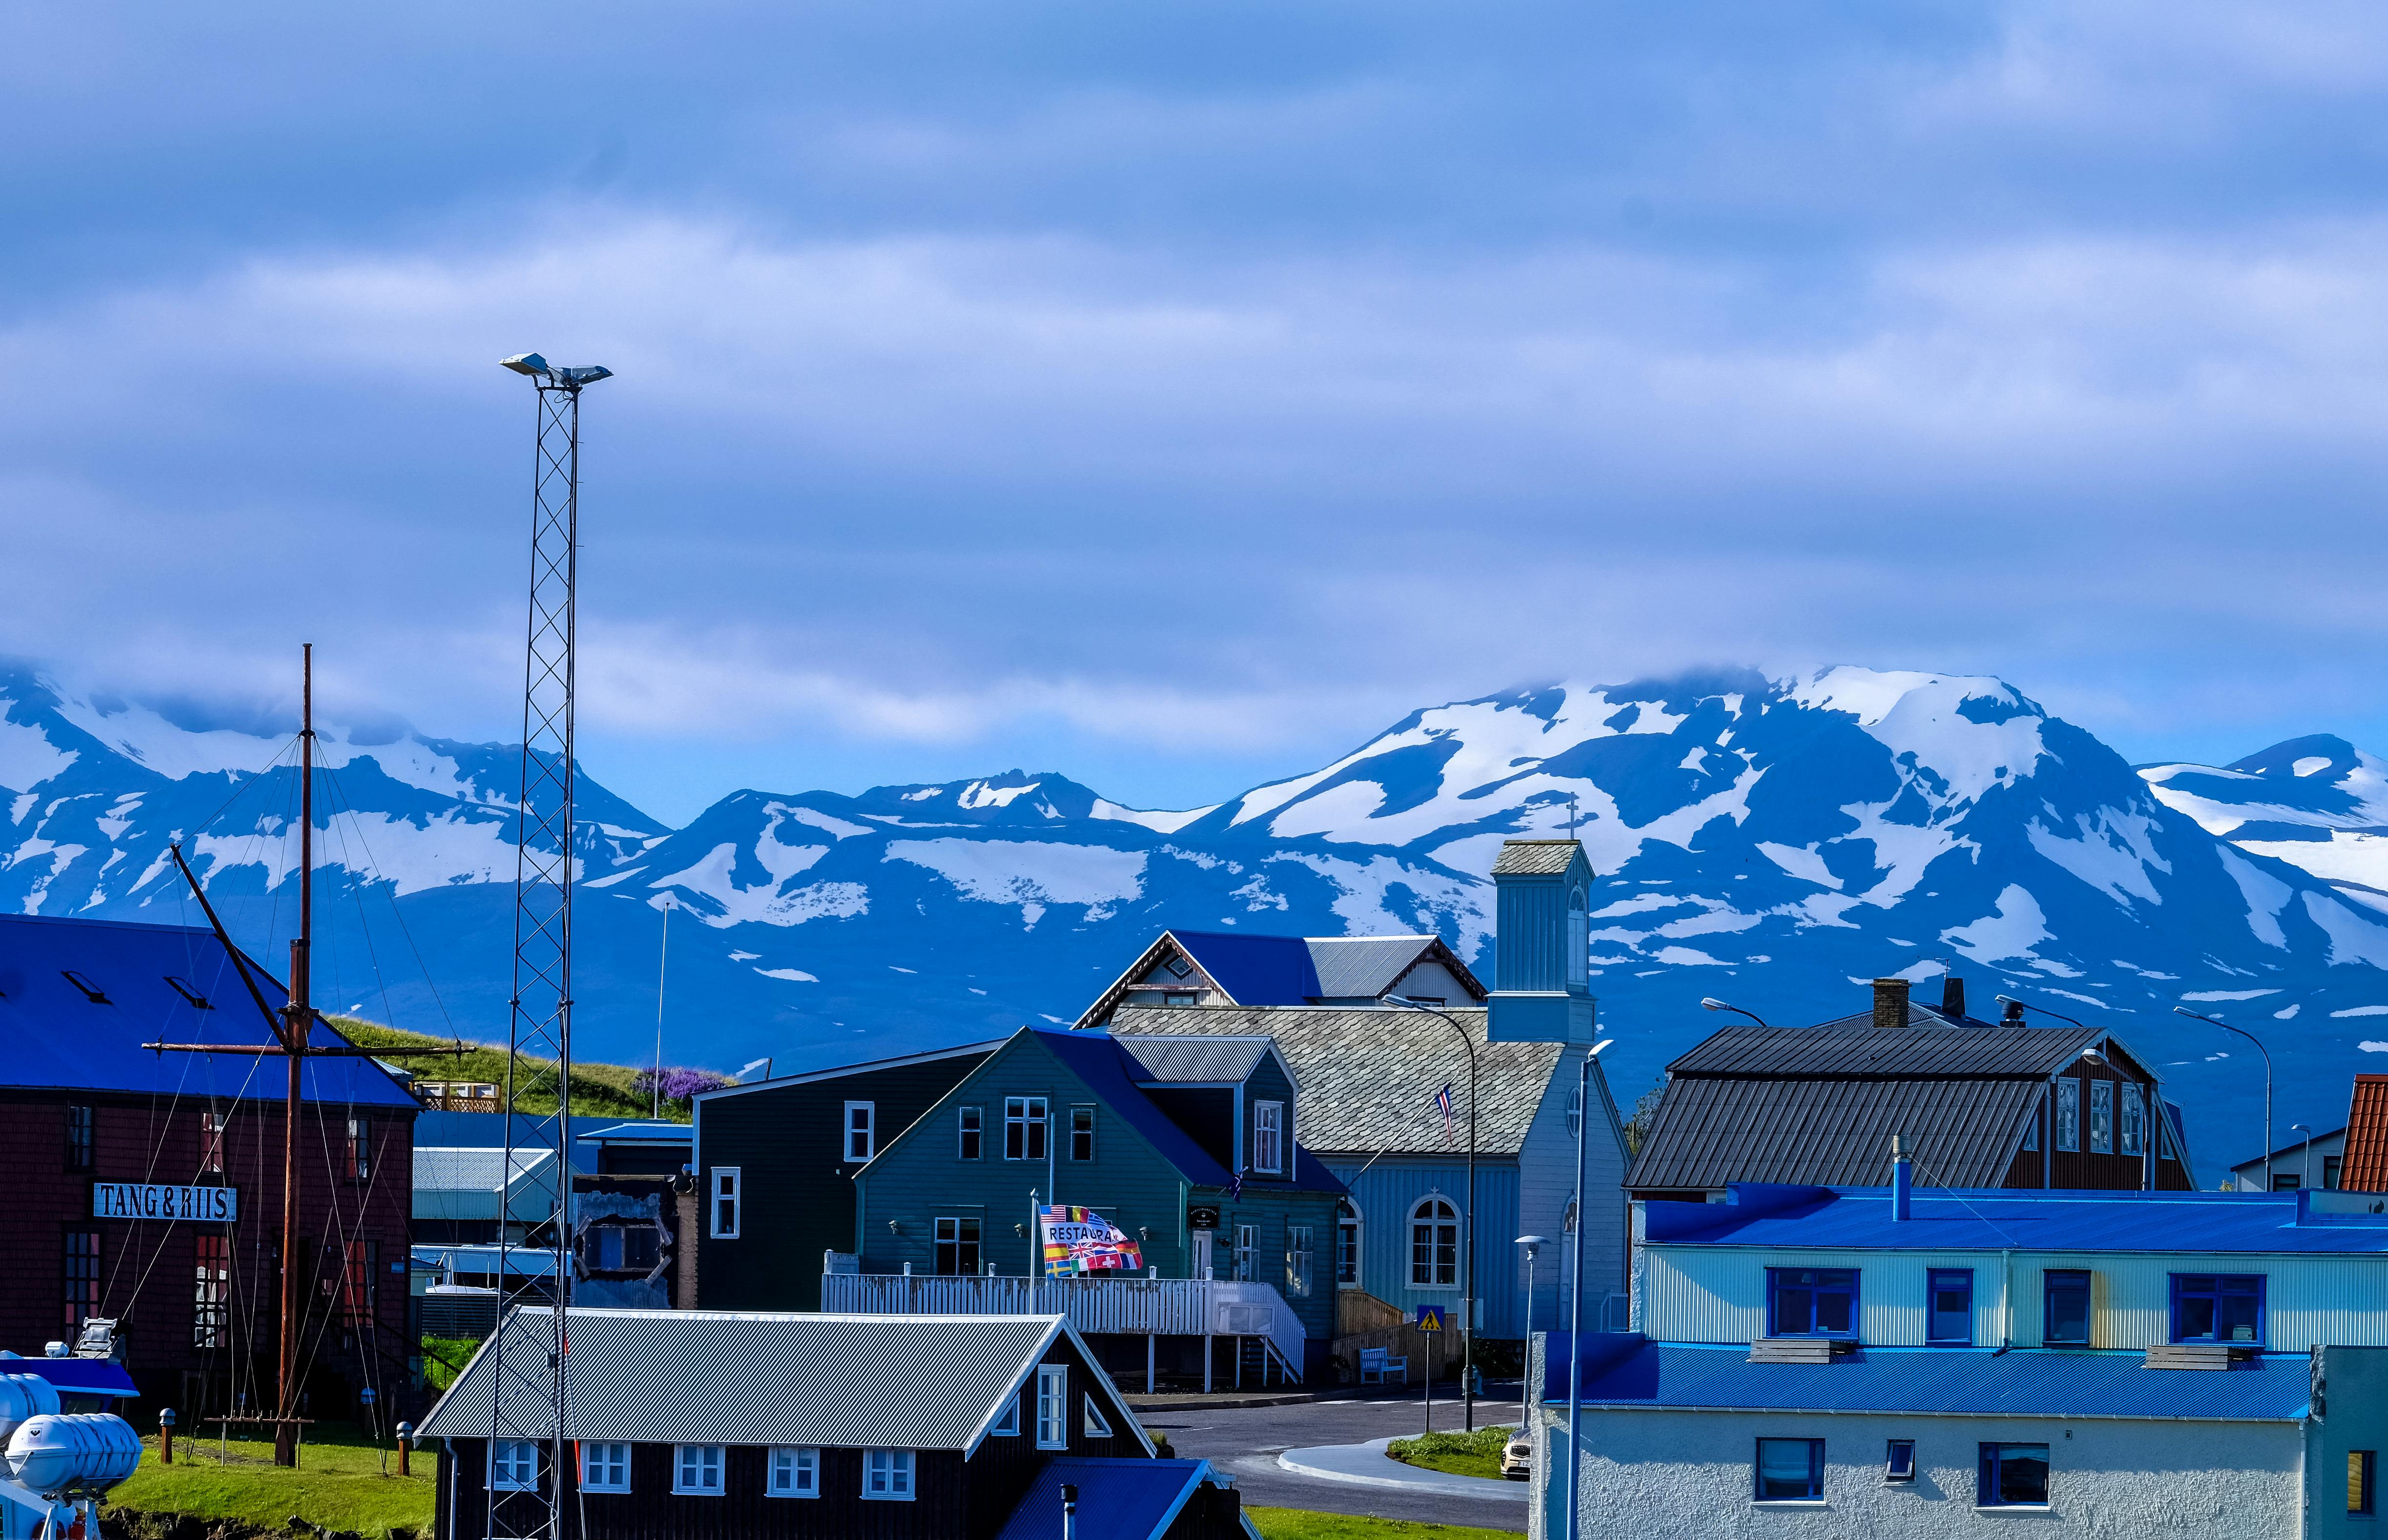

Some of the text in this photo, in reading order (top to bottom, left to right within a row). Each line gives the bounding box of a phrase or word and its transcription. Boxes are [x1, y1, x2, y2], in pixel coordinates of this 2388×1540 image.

[100, 1185, 227, 1219] TANG & RIIS
[1049, 1227, 1112, 1242] RESTAURA
